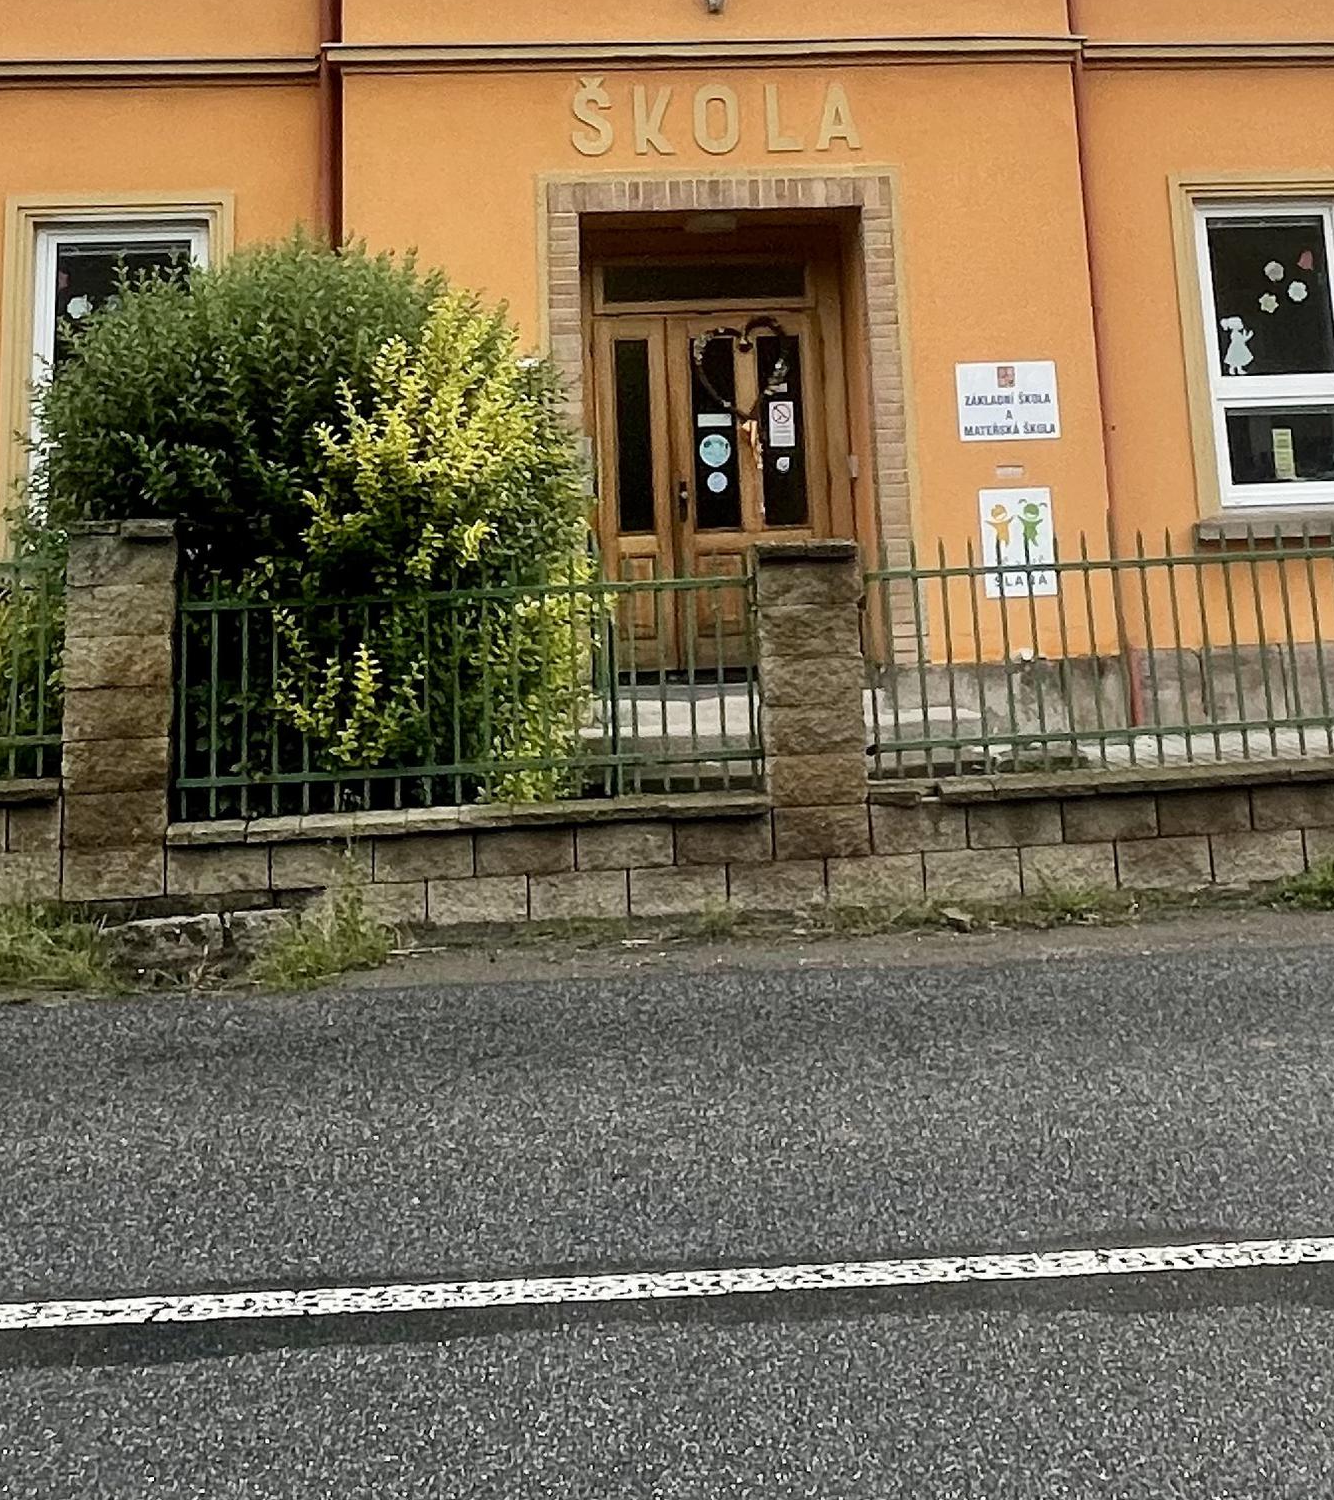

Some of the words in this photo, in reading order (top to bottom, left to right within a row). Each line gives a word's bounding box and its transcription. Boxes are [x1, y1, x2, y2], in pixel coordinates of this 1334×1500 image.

[571, 76, 862, 156] ŠKOLA
[964, 392, 1014, 406] ZÁKLADNÍ
[1018, 391, 1051, 405] ŠKOLA
[1005, 409, 1013, 420] A
[964, 422, 1019, 436] MATEŘSKÁ
[1023, 421, 1056, 434] ŠKOLA
